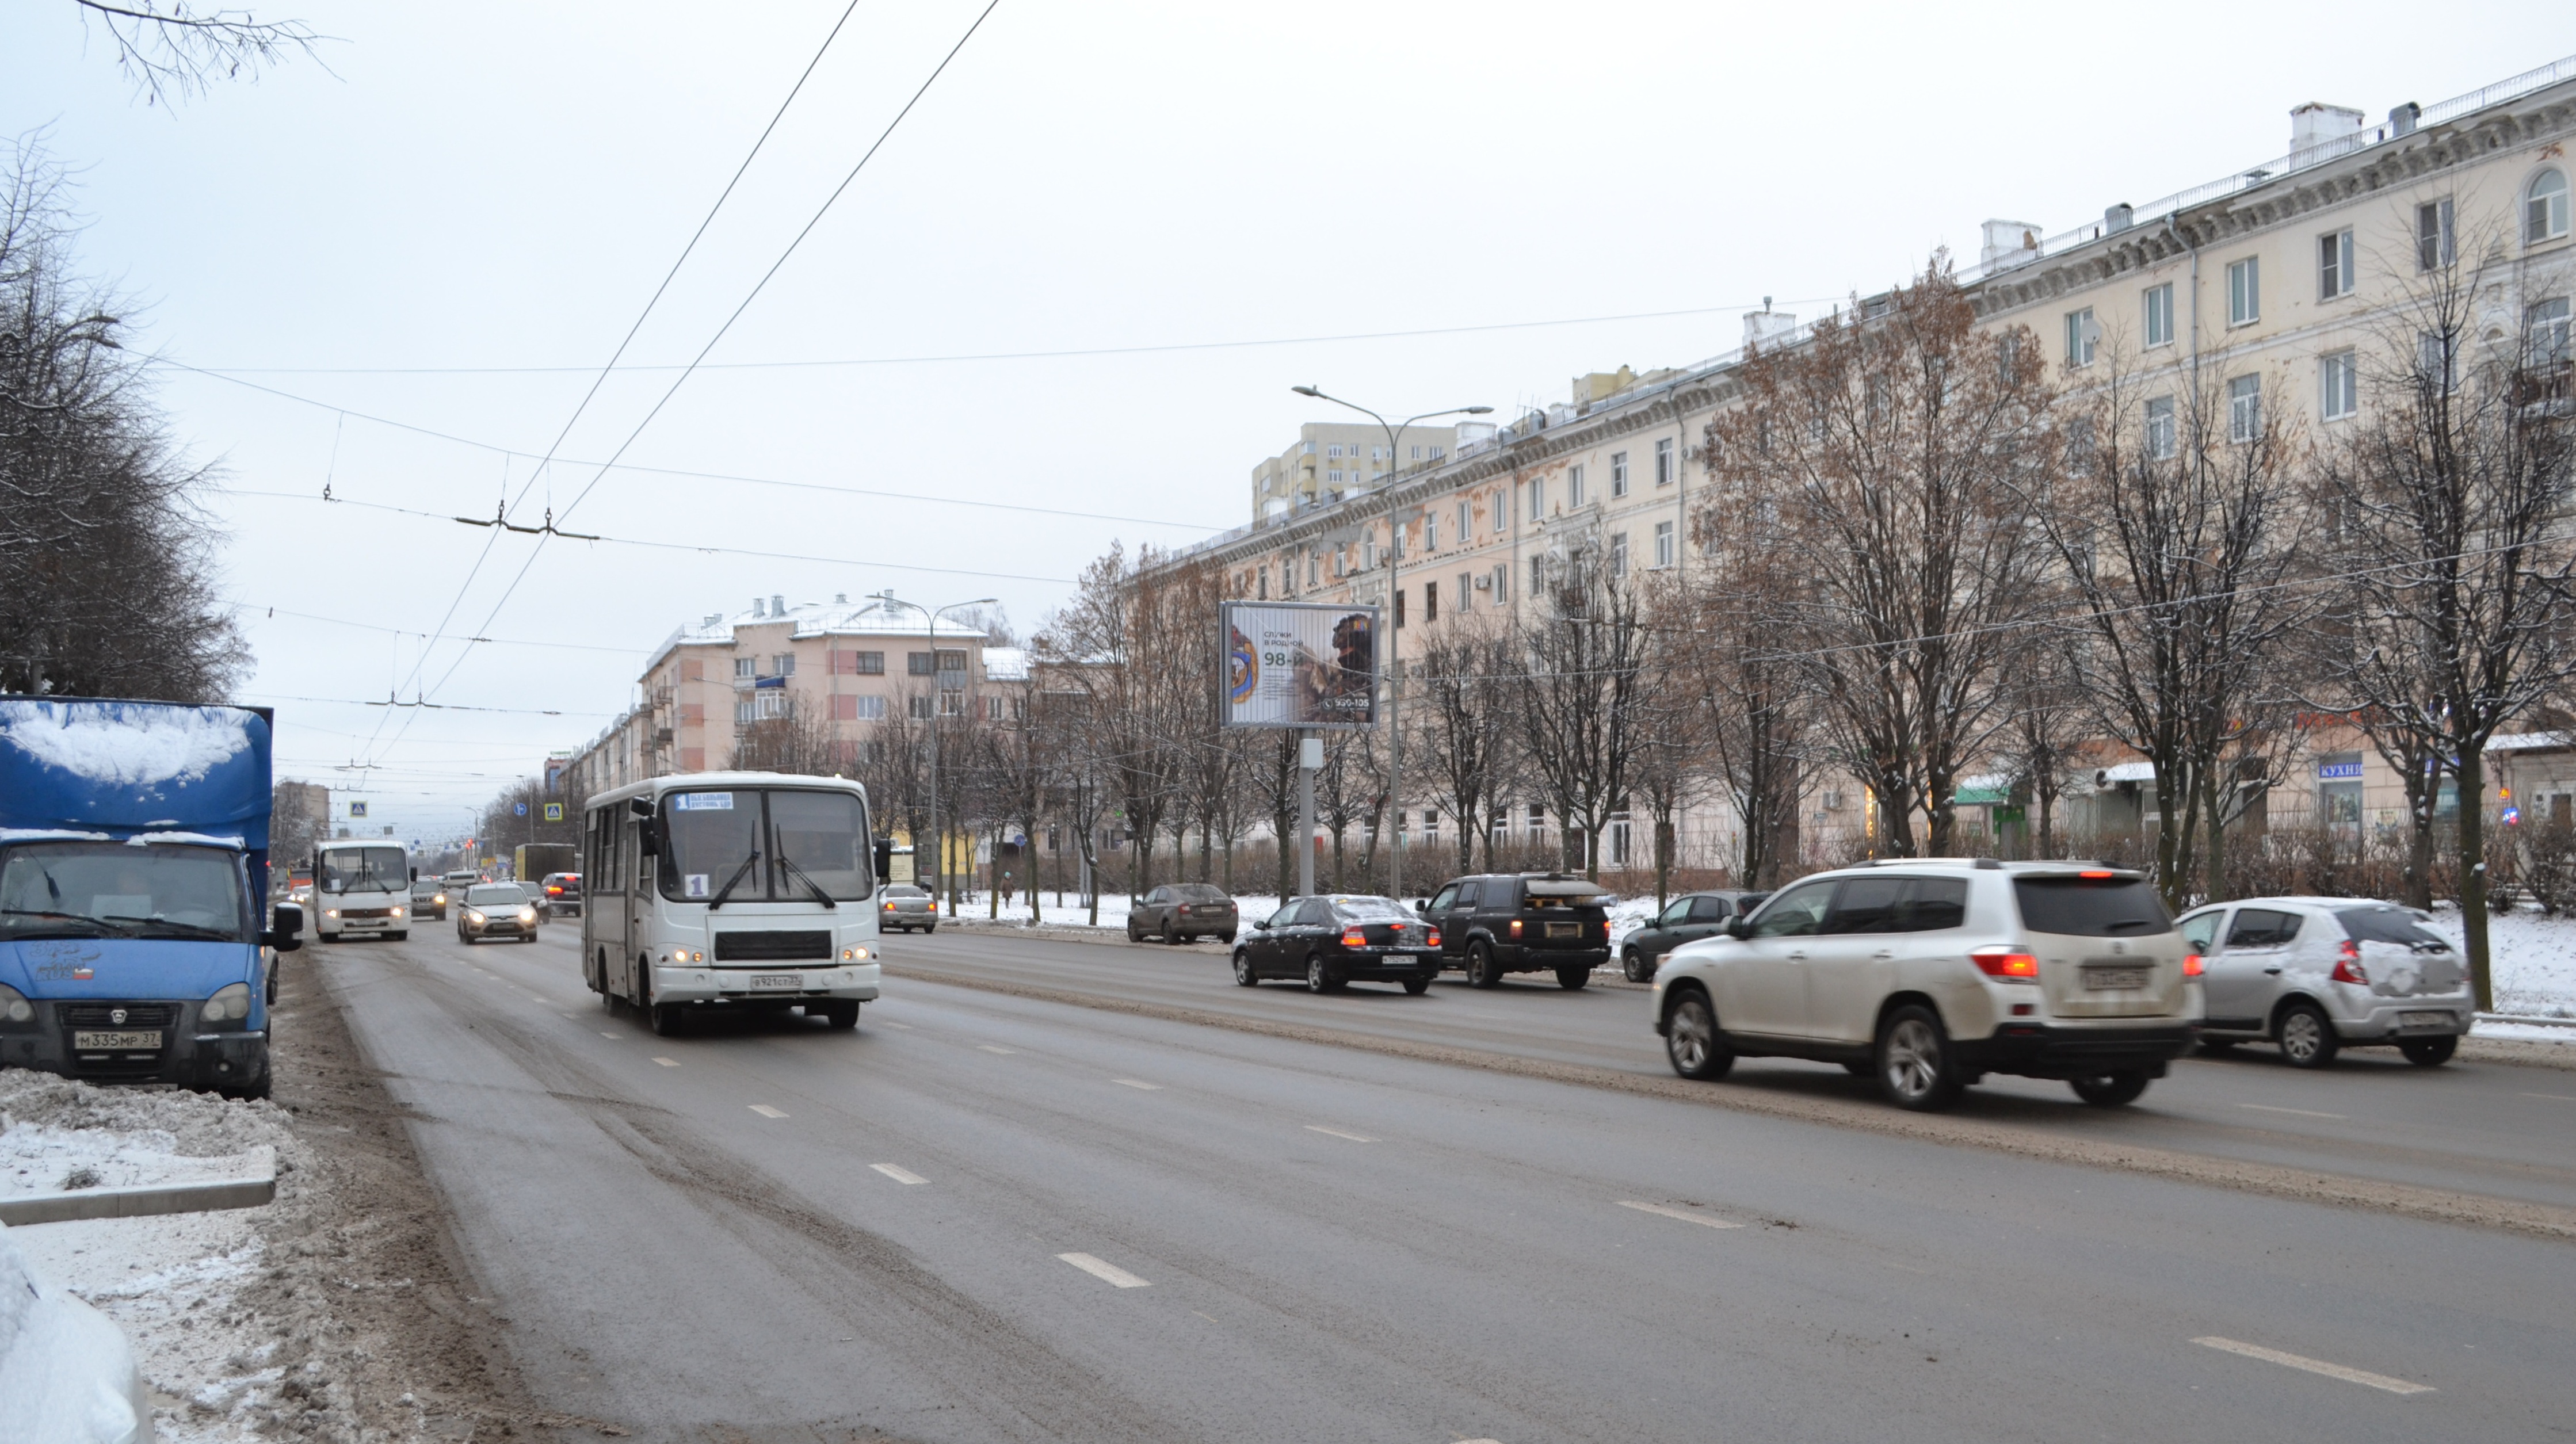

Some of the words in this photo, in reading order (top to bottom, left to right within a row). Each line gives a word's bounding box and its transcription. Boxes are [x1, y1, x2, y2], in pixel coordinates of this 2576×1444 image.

[1271, 639, 1304, 647] РОДНОЙ
[2321, 764, 2363, 776] КУХНИ
[678, 794, 688, 809] 1
[691, 876, 704, 895] 1
[80, 1034, 138, 1046] М335МР
[143, 1033, 157, 1042] 37
